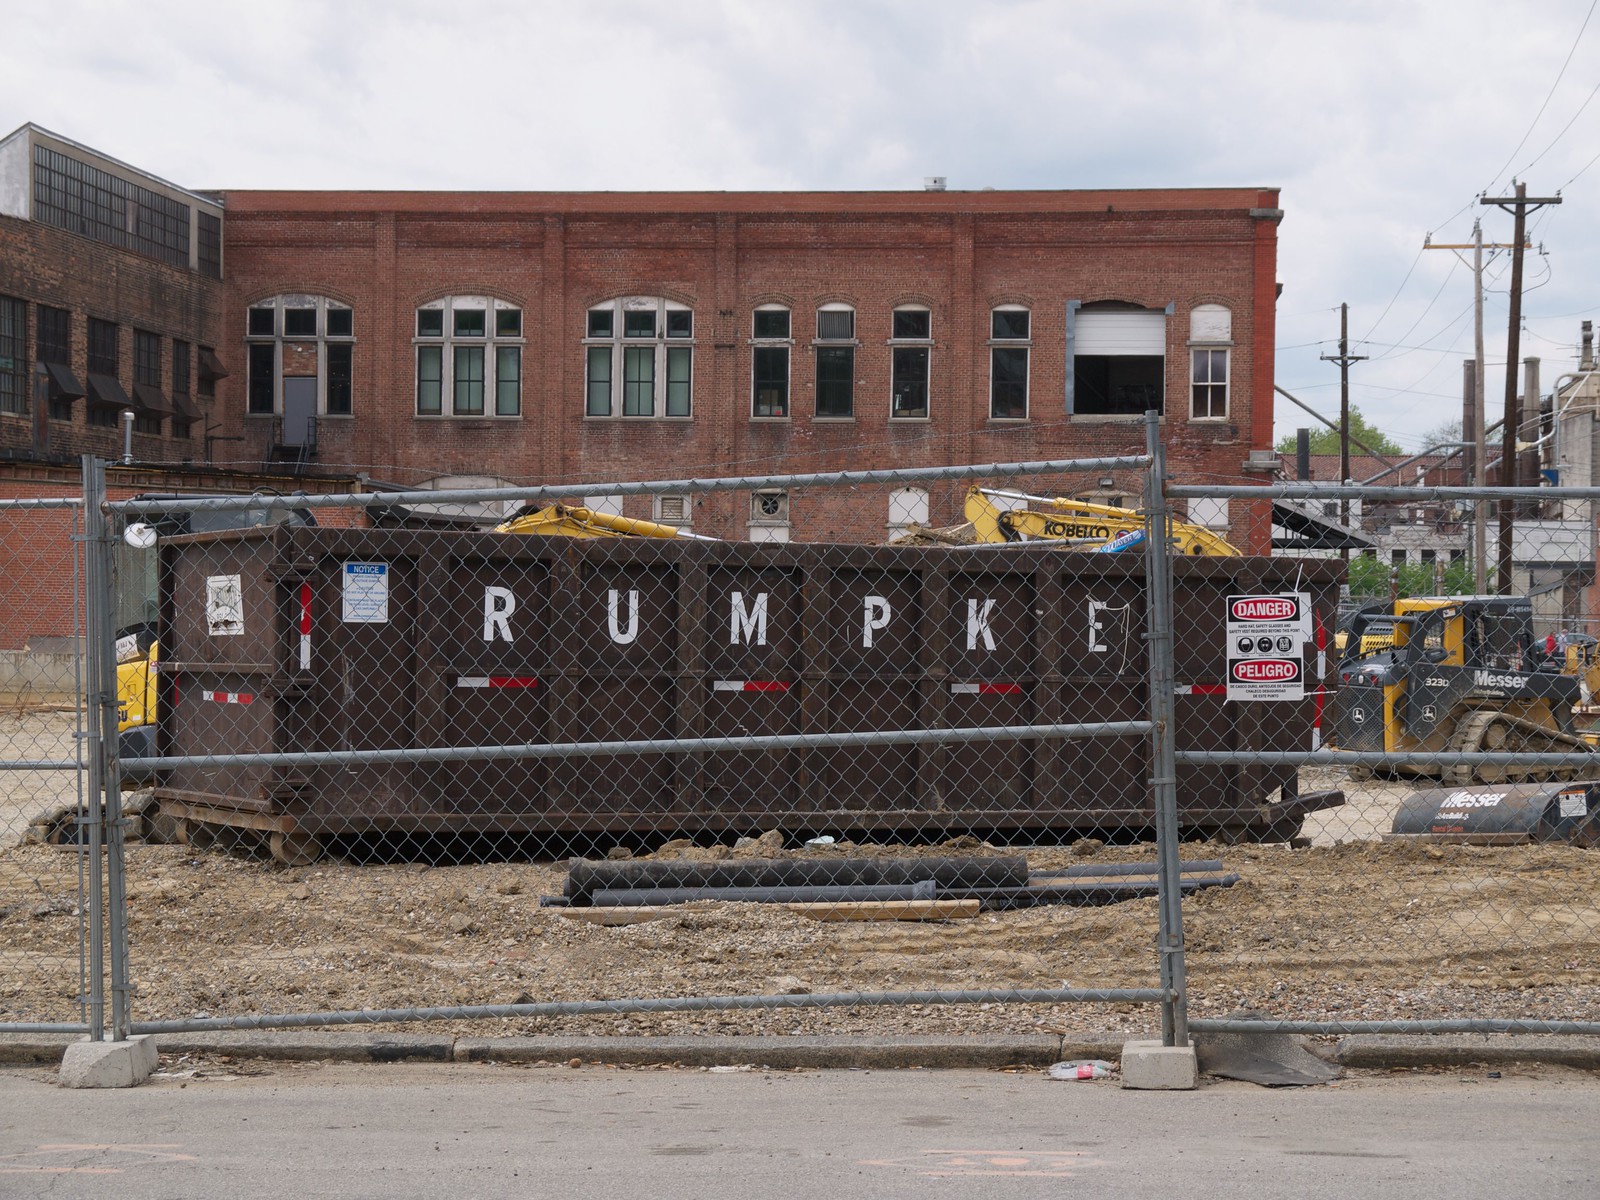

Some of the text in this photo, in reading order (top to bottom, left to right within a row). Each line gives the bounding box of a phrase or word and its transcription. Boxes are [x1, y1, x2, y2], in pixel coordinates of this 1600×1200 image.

[1044, 521, 1110, 539] KOBELCO
[353, 565, 380, 574] NOTICE
[1237, 602, 1292, 616] DANGER
[1238, 664, 1293, 677] PELIGRO
[1425, 678, 1449, 687] 323D
[1473, 670, 1529, 688] Messer
[1440, 791, 1507, 808] Messer
